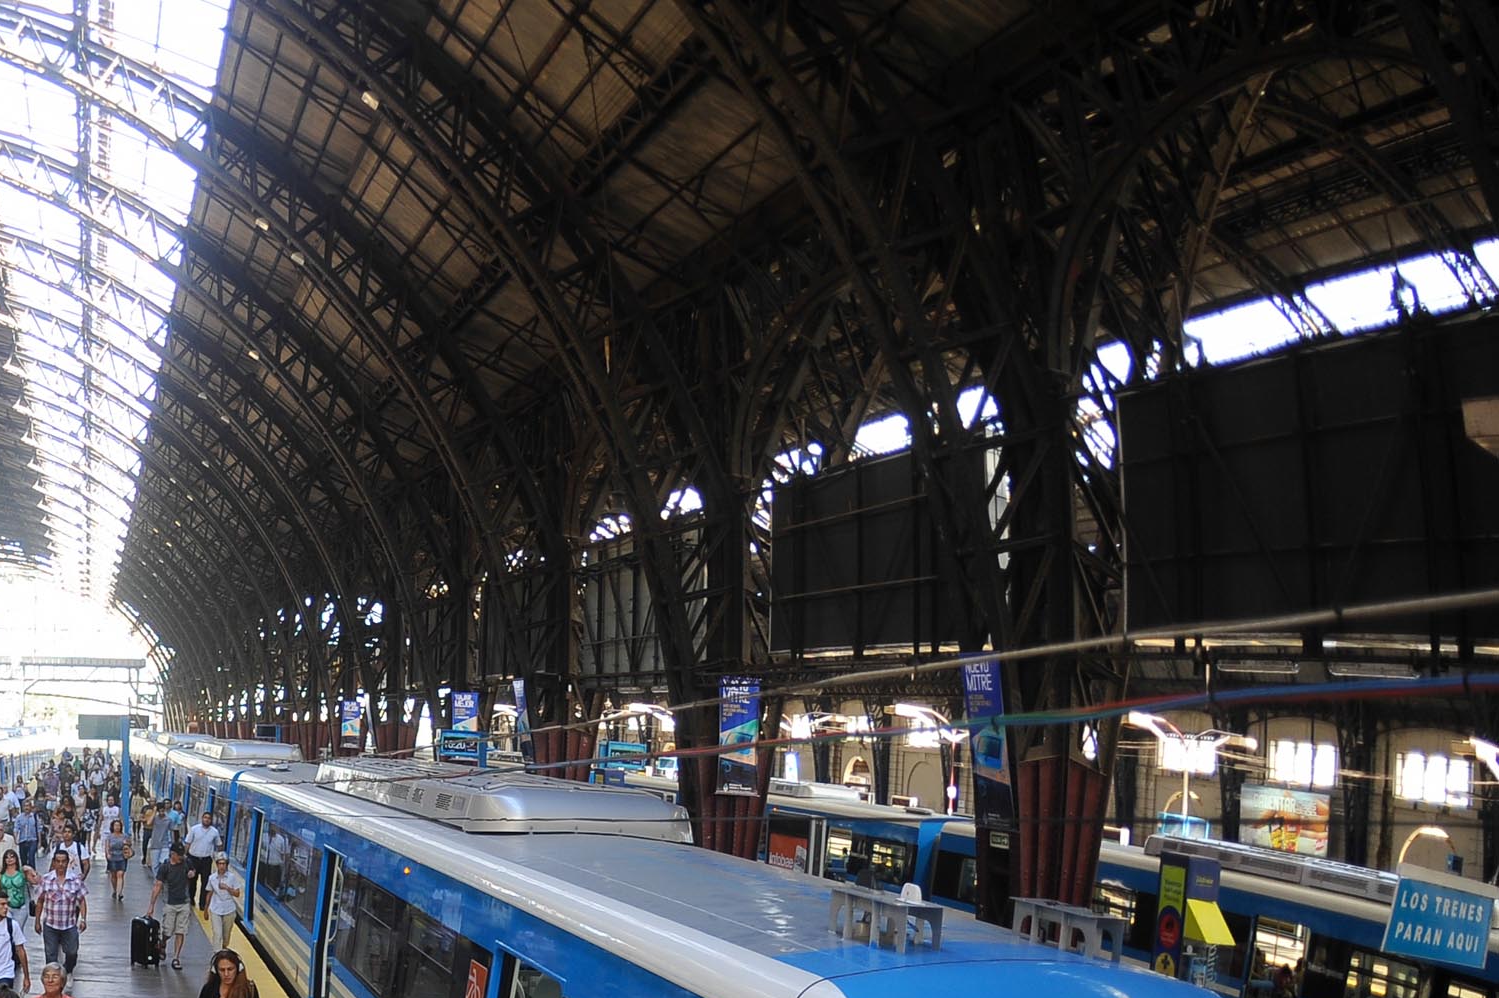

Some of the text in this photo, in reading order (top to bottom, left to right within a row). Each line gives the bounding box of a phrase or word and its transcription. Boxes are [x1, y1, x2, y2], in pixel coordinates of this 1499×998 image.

[965, 673, 993, 692] MITRE
[1401, 891, 1484, 923] LOS TRENES
[1395, 922, 1479, 953] PARAN AQUI
